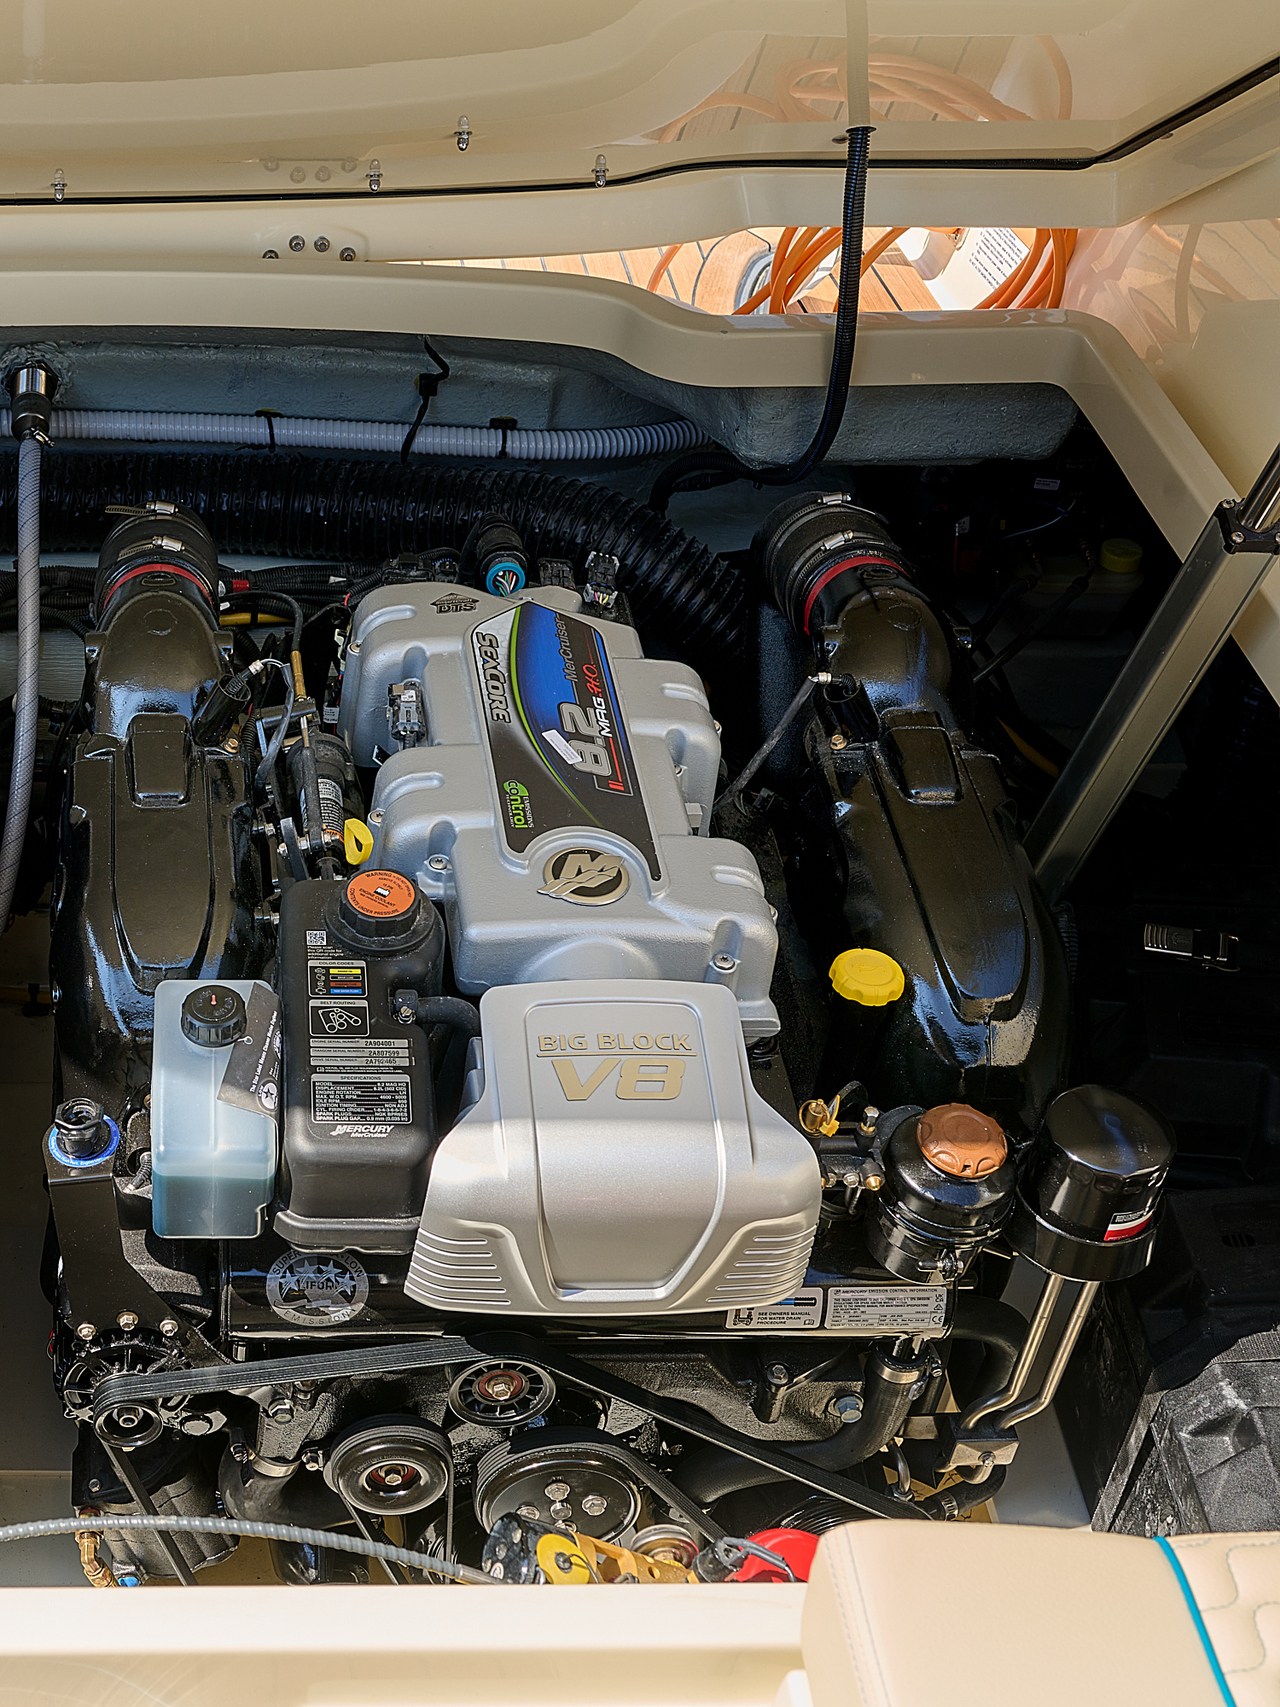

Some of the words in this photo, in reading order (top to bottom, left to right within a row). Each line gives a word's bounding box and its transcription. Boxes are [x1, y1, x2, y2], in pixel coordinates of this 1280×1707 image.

[437, 603, 476, 614] DTS
[558, 615, 578, 682] MerCruiser
[477, 632, 511, 724] SEACORE
[359, 888, 375, 897] ENGINE
[375, 894, 396, 907] COOLANT
[358, 905, 373, 914] UNDER
[538, 1034, 588, 1051] BIG
[597, 1033, 693, 1050] BLOCK
[551, 1058, 686, 1101] V8
[330, 1125, 394, 1135] MERCURY
[272, 1250, 301, 1275] SUPER
[344, 1256, 365, 1278] LOW
